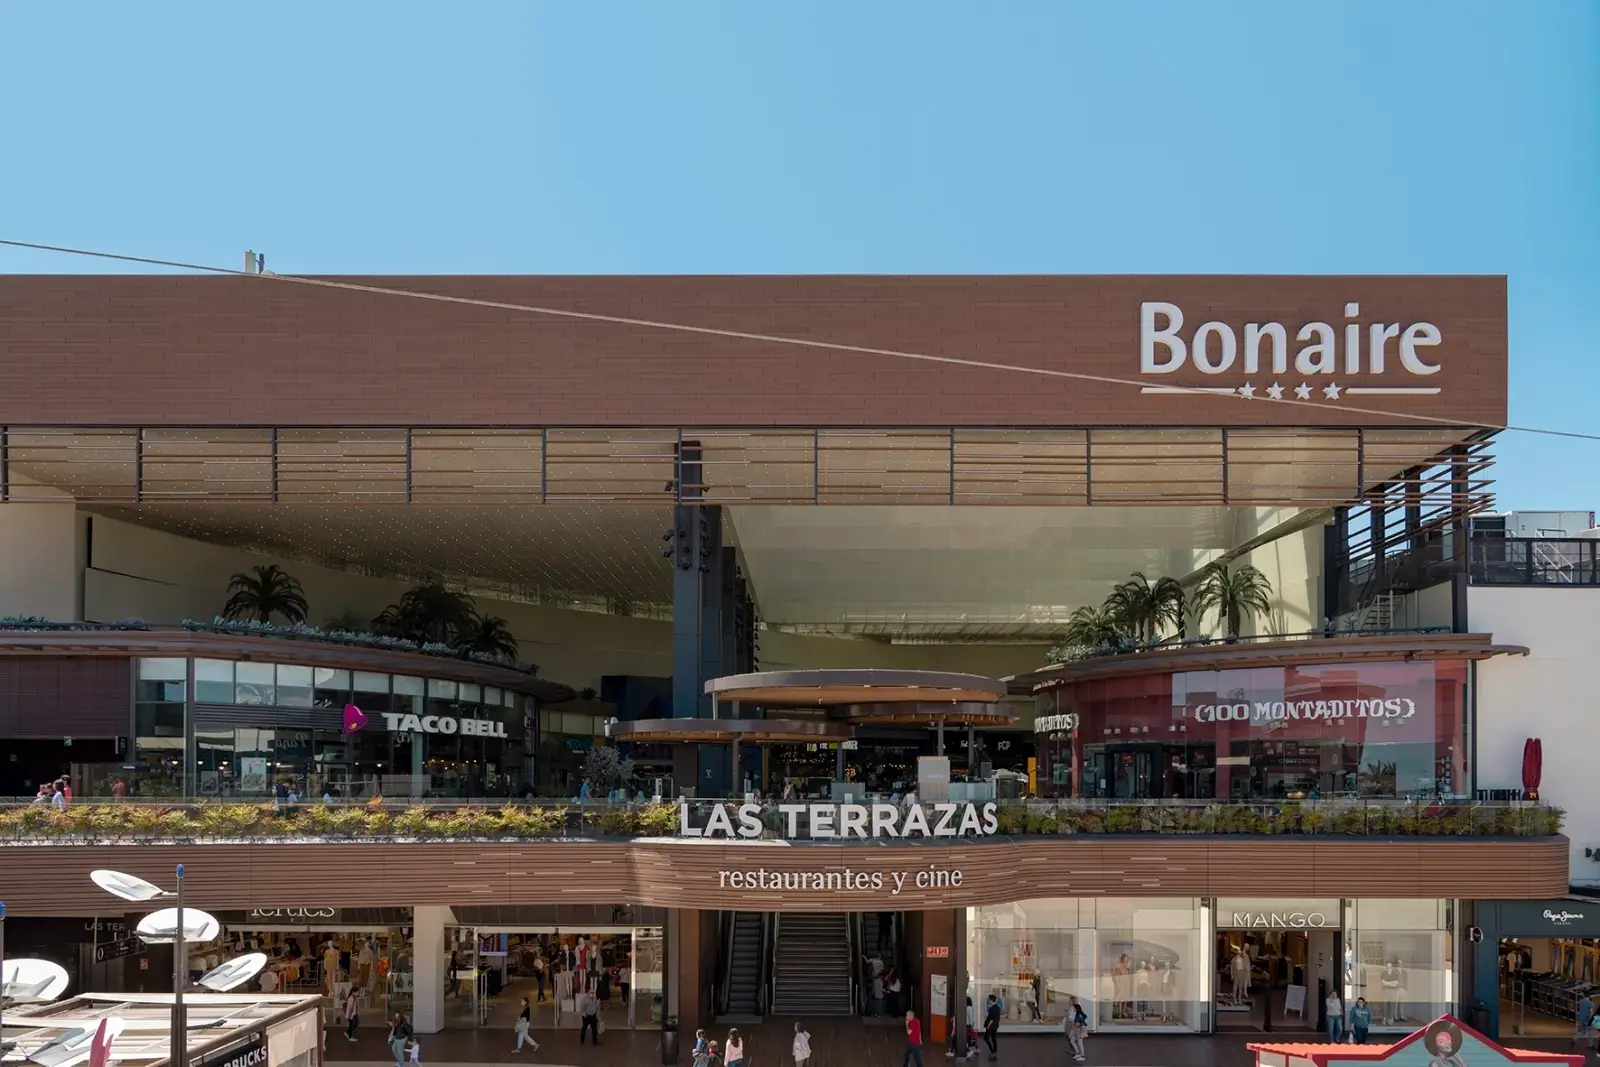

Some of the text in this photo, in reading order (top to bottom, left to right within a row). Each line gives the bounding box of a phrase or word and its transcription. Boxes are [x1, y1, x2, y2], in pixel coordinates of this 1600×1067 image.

[1141, 302, 1442, 375] Bonaire
[381, 712, 457, 735] TACO
[460, 718, 508, 738] BELL
[680, 802, 999, 839] LAS TERRAZAS
[718, 864, 963, 894] restaurantes y cine
[1233, 912, 1326, 928] MANGO
